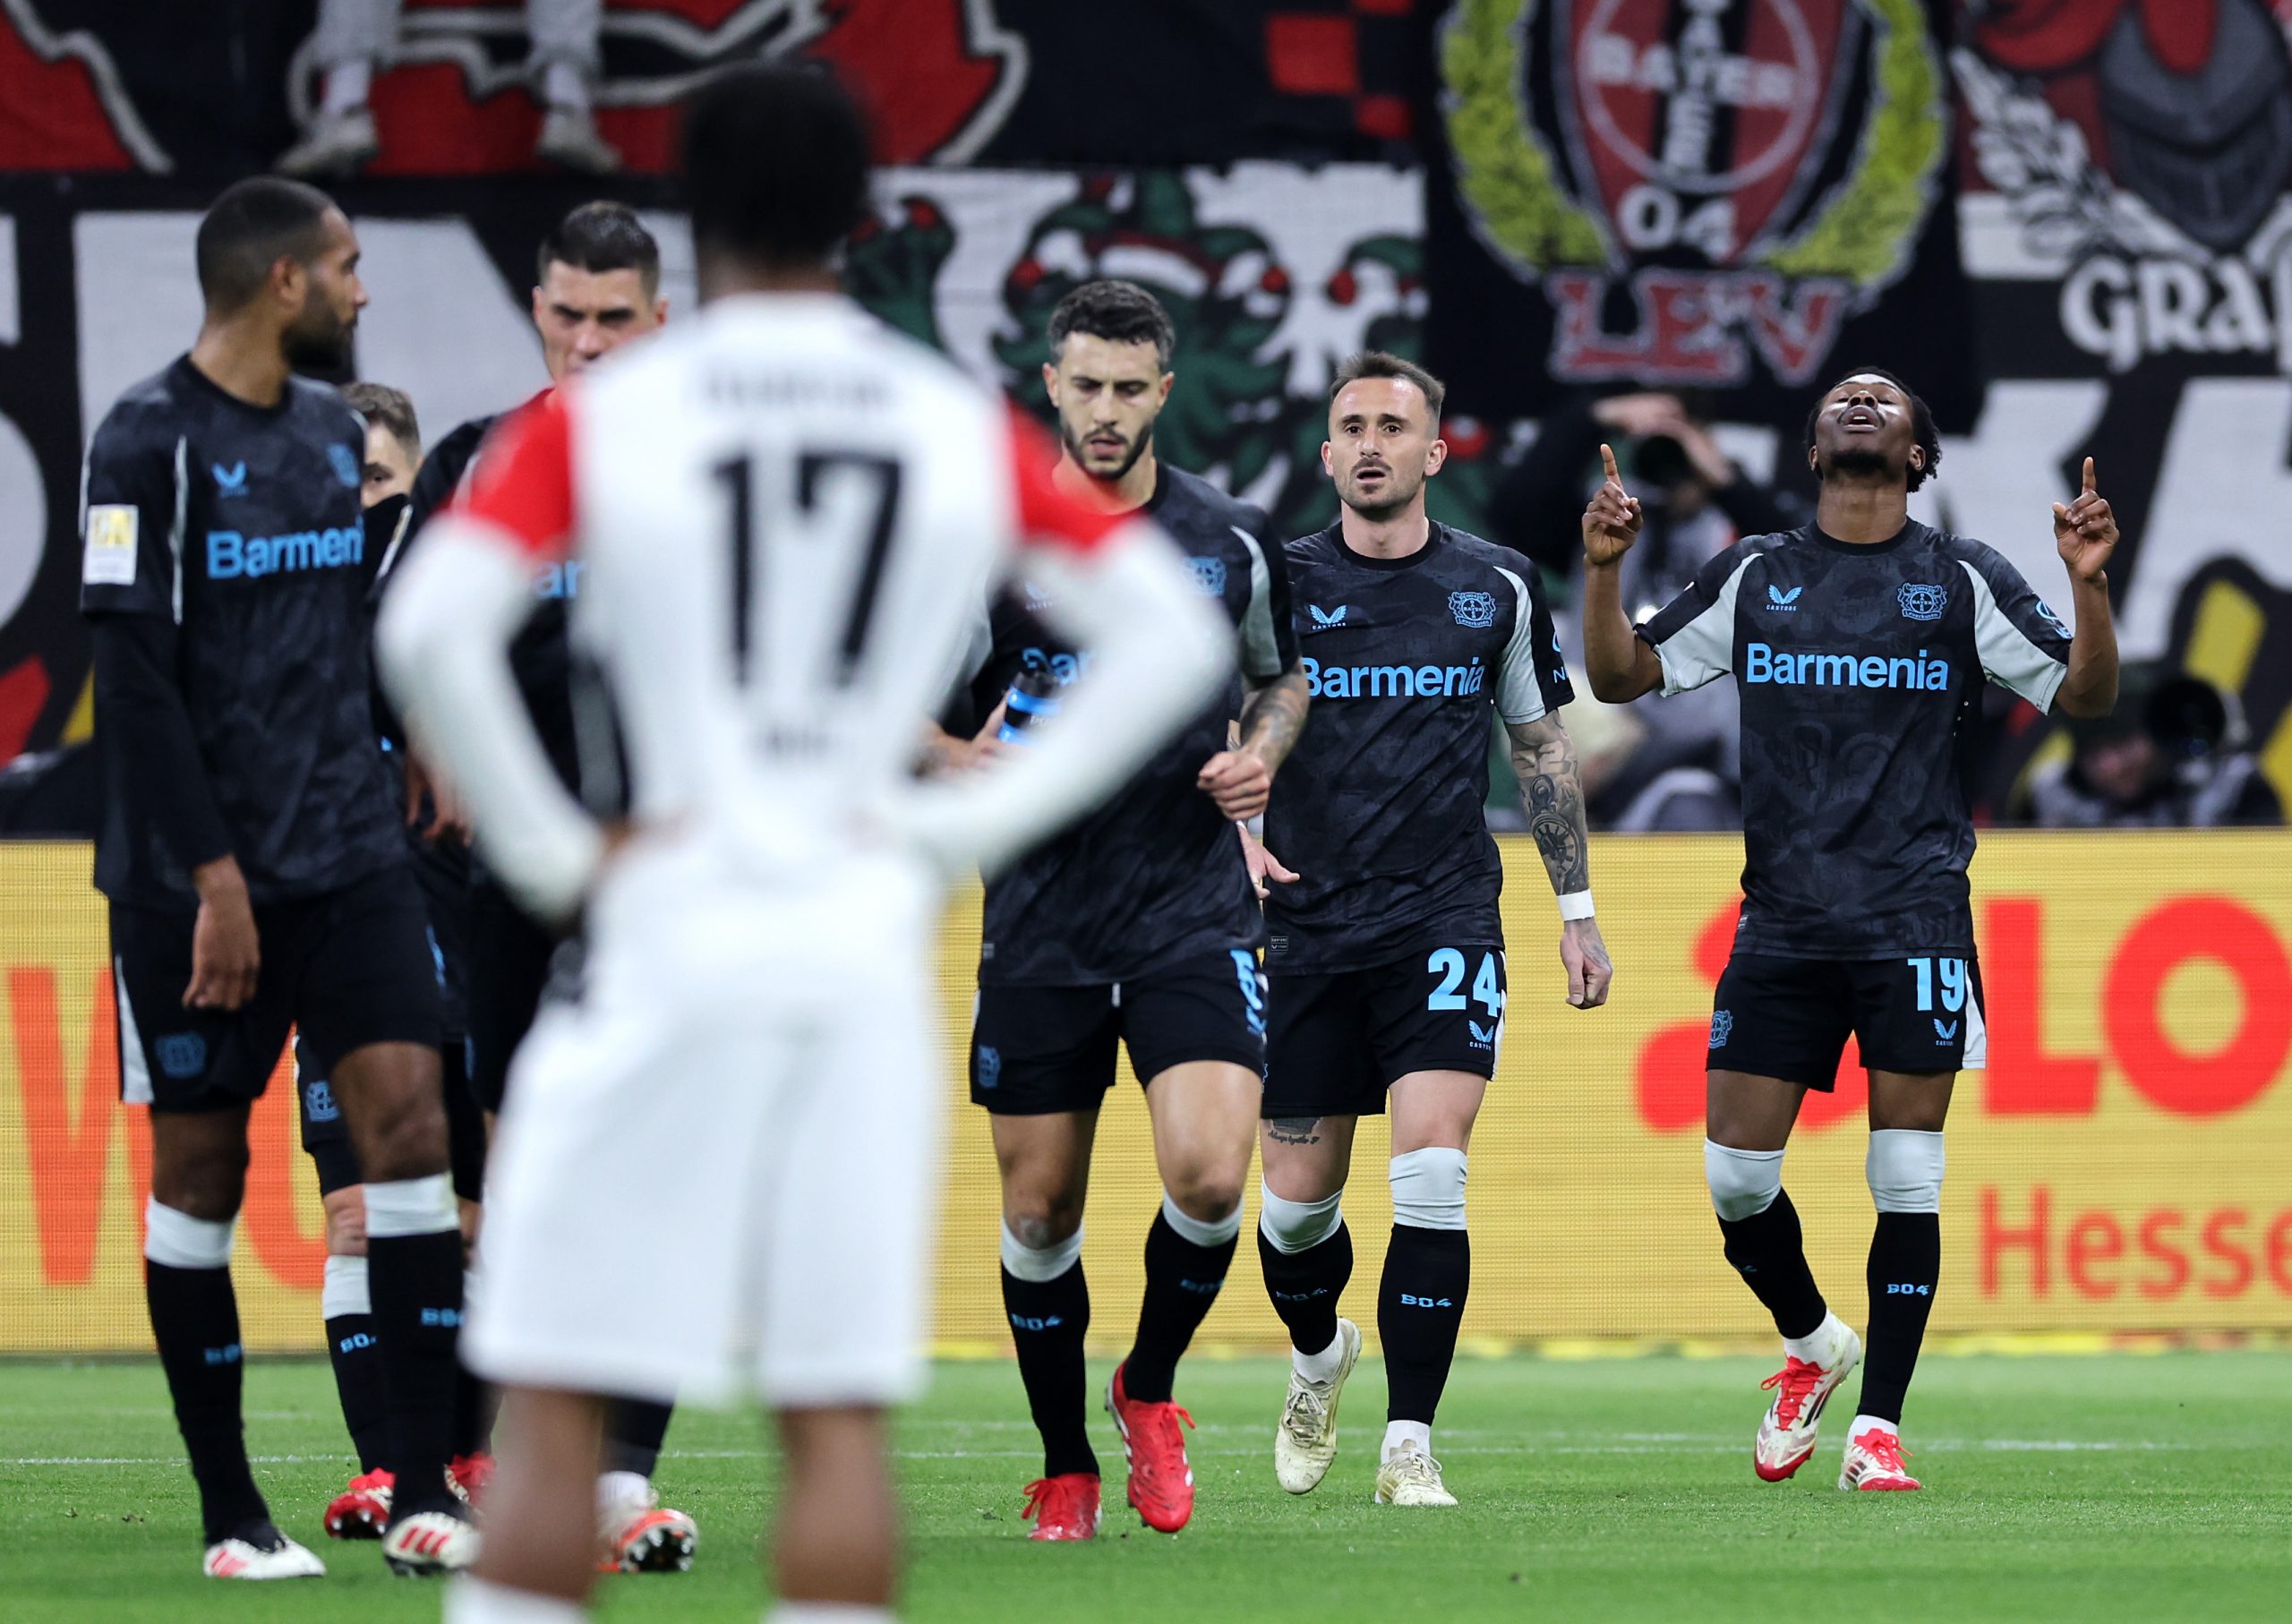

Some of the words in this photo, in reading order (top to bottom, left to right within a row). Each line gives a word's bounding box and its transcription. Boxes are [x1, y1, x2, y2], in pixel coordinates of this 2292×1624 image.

[1618, 183, 1737, 261] 04
[1544, 269, 1847, 387] LEV
[708, 448, 906, 689] 17
[1301, 656, 1486, 698] Barmenia
[1746, 642, 1949, 691] Barmenia
[1427, 947, 1501, 1018] 24
[1907, 957, 1965, 1013] 19
